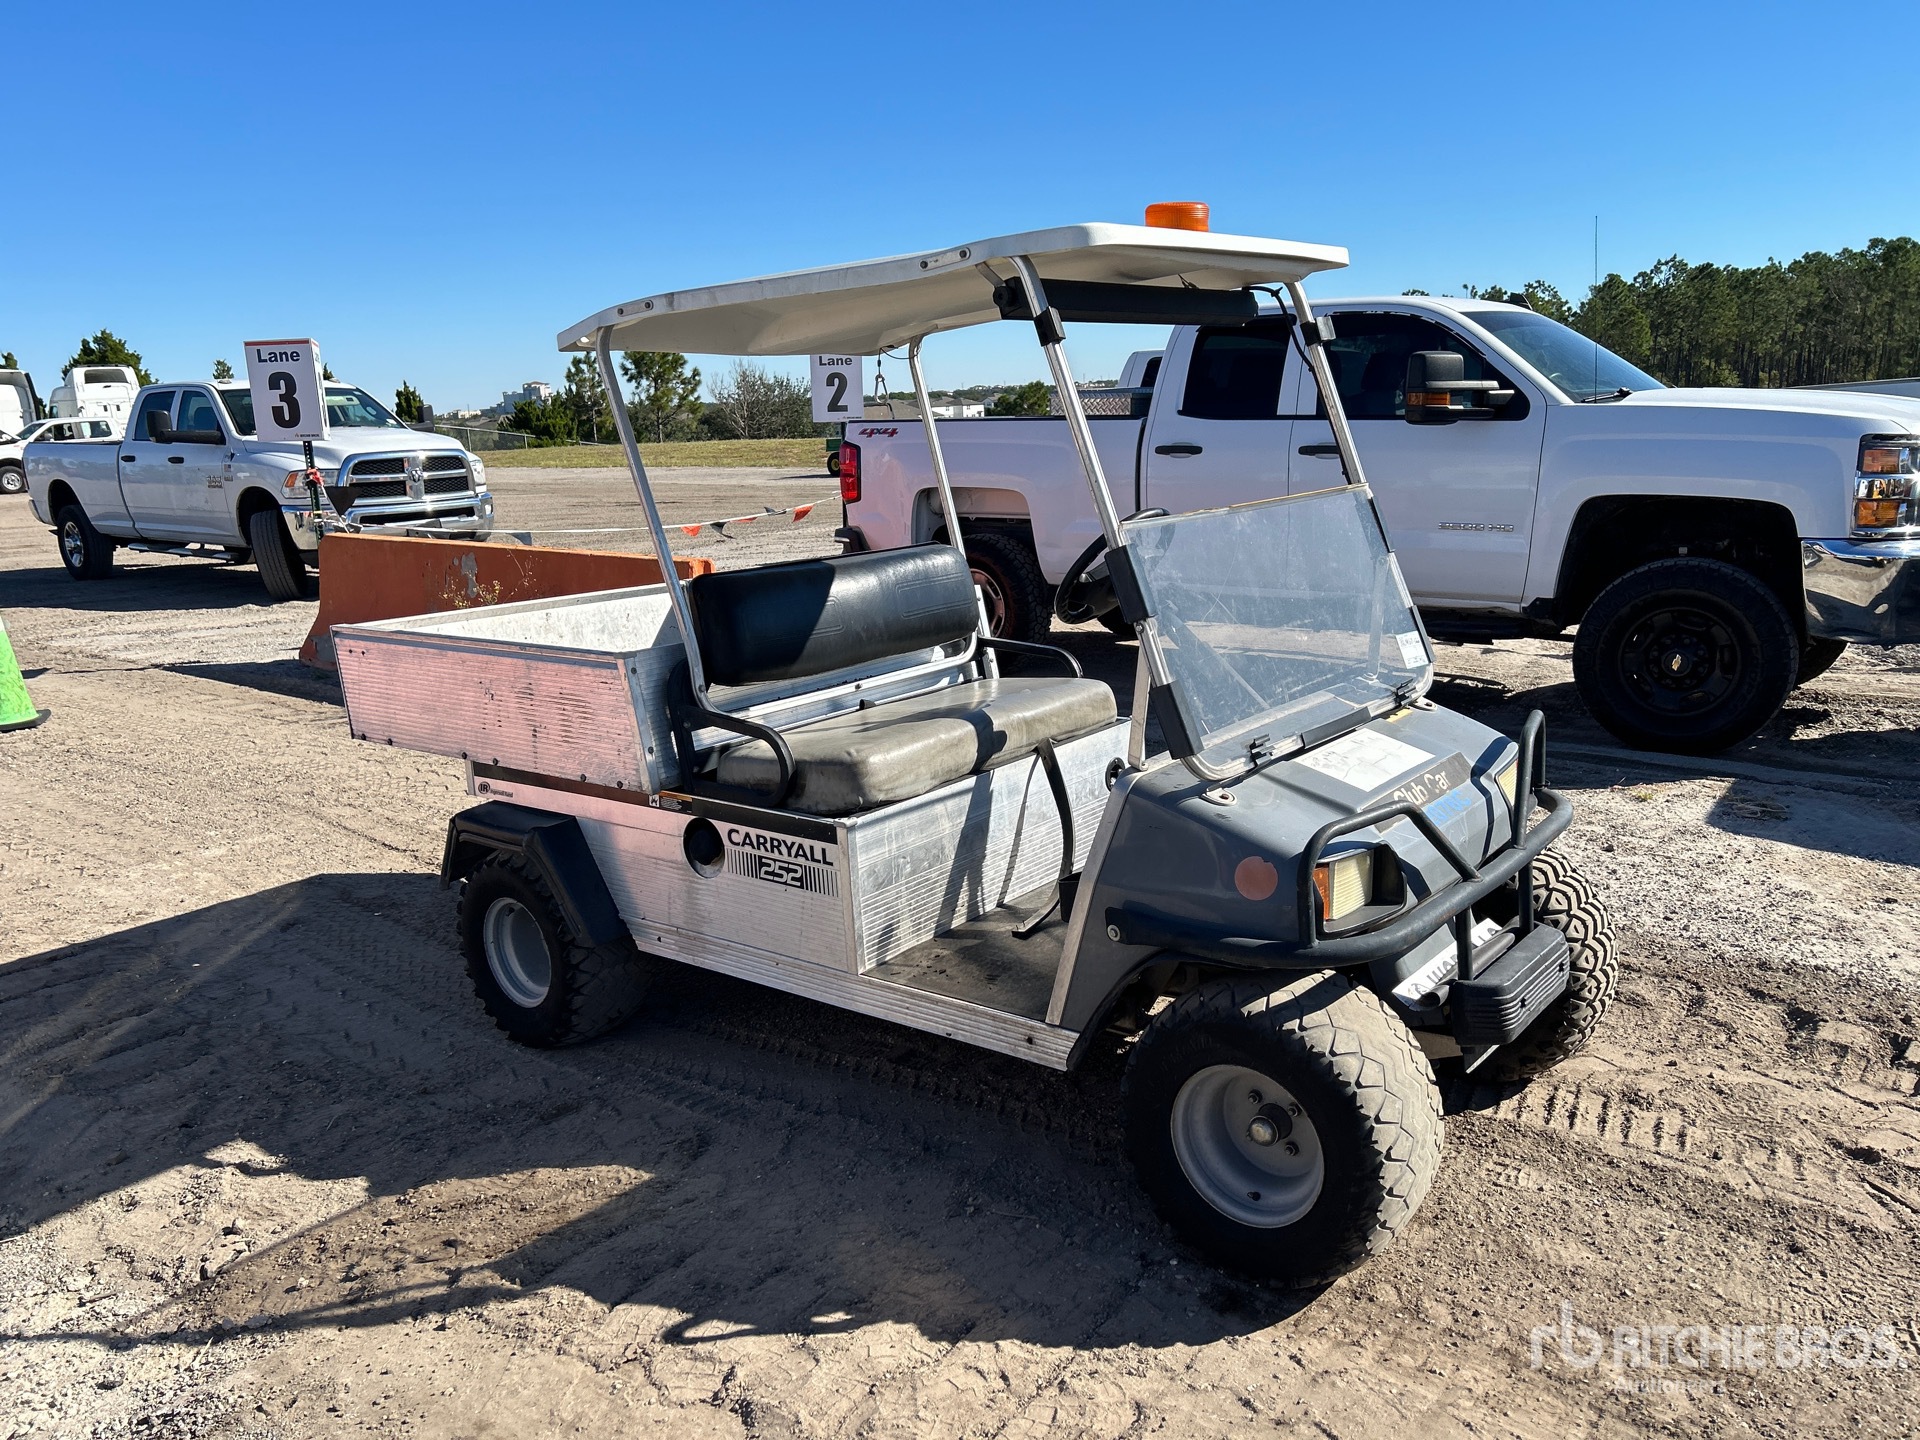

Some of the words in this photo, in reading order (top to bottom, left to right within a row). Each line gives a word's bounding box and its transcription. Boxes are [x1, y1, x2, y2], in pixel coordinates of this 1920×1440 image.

[256, 348, 300, 363] Lane
[818, 355, 853, 366] Lane
[268, 371, 301, 429] 3
[826, 371, 849, 412] 2
[1487, 523, 1514, 533] HD
[1393, 781, 1429, 806] Club
[1423, 770, 1451, 794] Car
[727, 828, 834, 867] CARRYALL
[760, 858, 803, 887] 252
